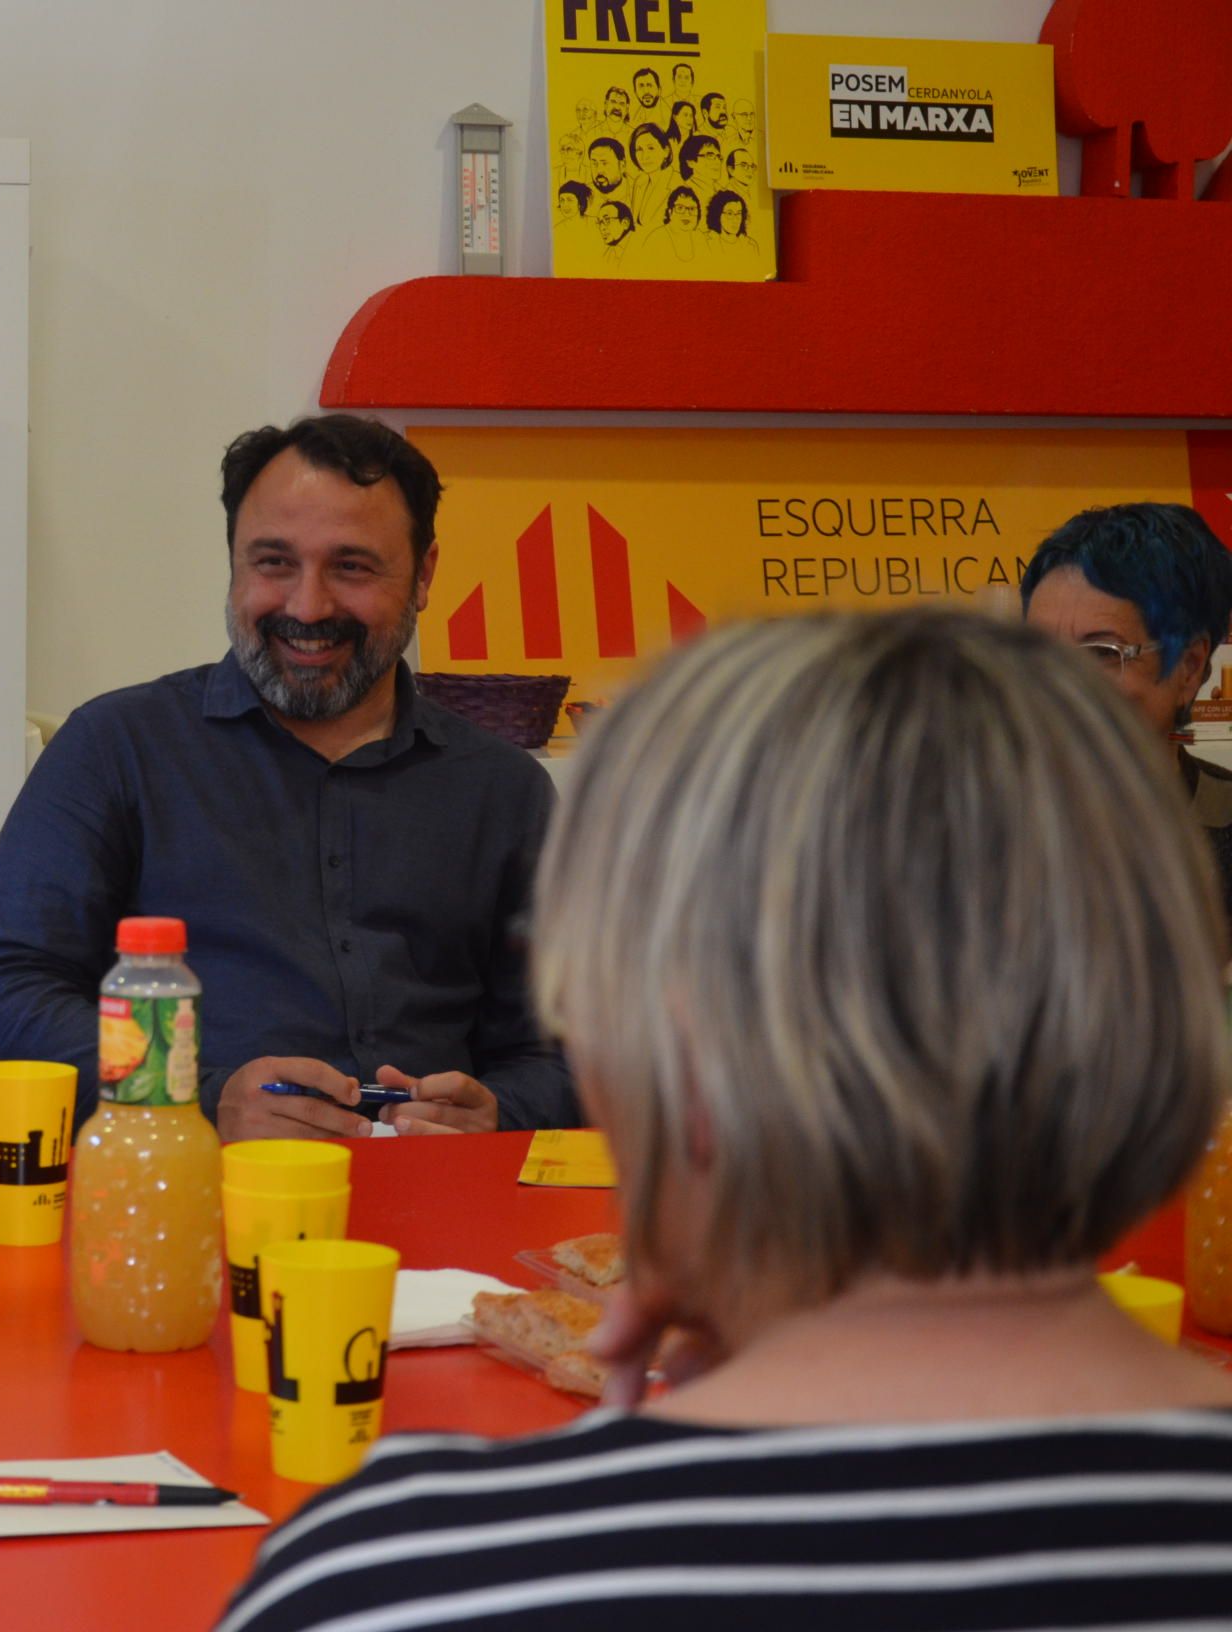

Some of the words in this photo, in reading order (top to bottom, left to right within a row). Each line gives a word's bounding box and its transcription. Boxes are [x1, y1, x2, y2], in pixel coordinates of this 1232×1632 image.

[831, 73, 905, 93] POSEM
[908, 87, 993, 101] CERDANYOLA
[832, 103, 873, 129] EN
[879, 105, 993, 133] MARXA
[757, 498, 1001, 537] ESQUERRA
